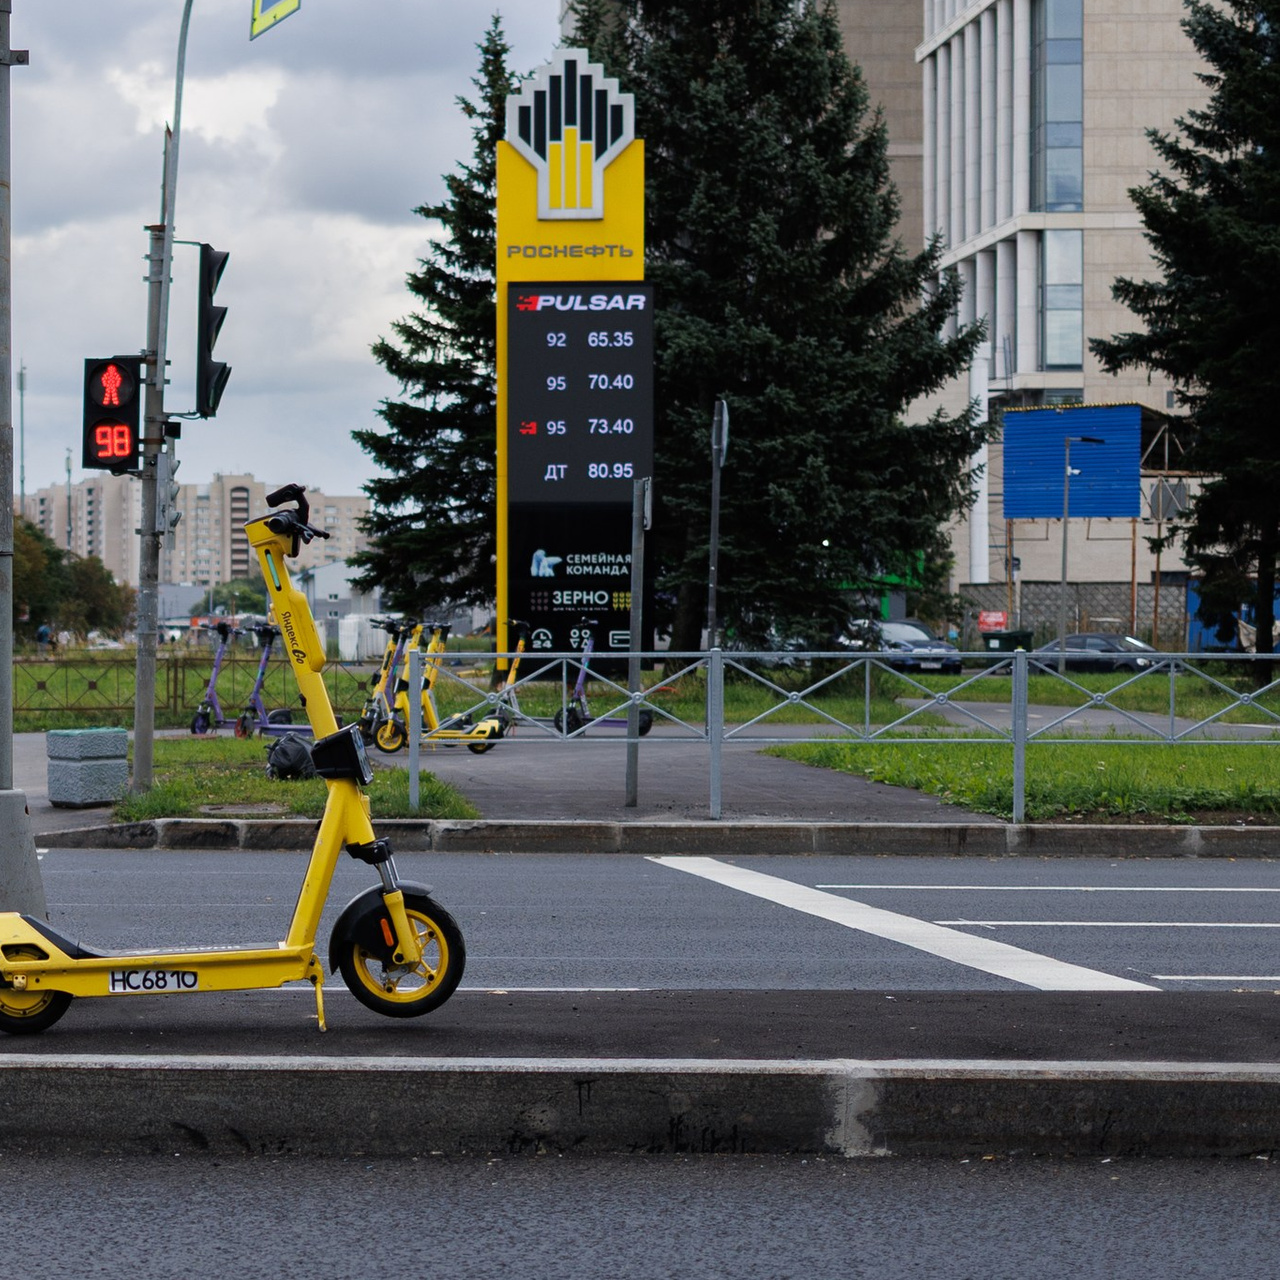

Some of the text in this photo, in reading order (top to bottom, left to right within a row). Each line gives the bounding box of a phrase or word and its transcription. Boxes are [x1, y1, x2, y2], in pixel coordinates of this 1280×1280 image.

[507, 244, 634, 258] РОСНЕФТЬ
[536, 295, 646, 311] PULSAR
[546, 332, 634, 347] 92 65.35
[546, 374, 634, 390] 95 70.40
[546, 419, 634, 435] 95 73.40
[95, 425, 131, 457] 98
[544, 463, 634, 481] ДТ 80.95
[566, 552, 632, 563] СЕМЕЙНАЯ
[566, 565, 629, 576] КОМАНДА
[552, 590, 609, 605] ЗЕРНО
[281, 611, 307, 664] Яндекс Go
[532, 640, 553, 649] 24
